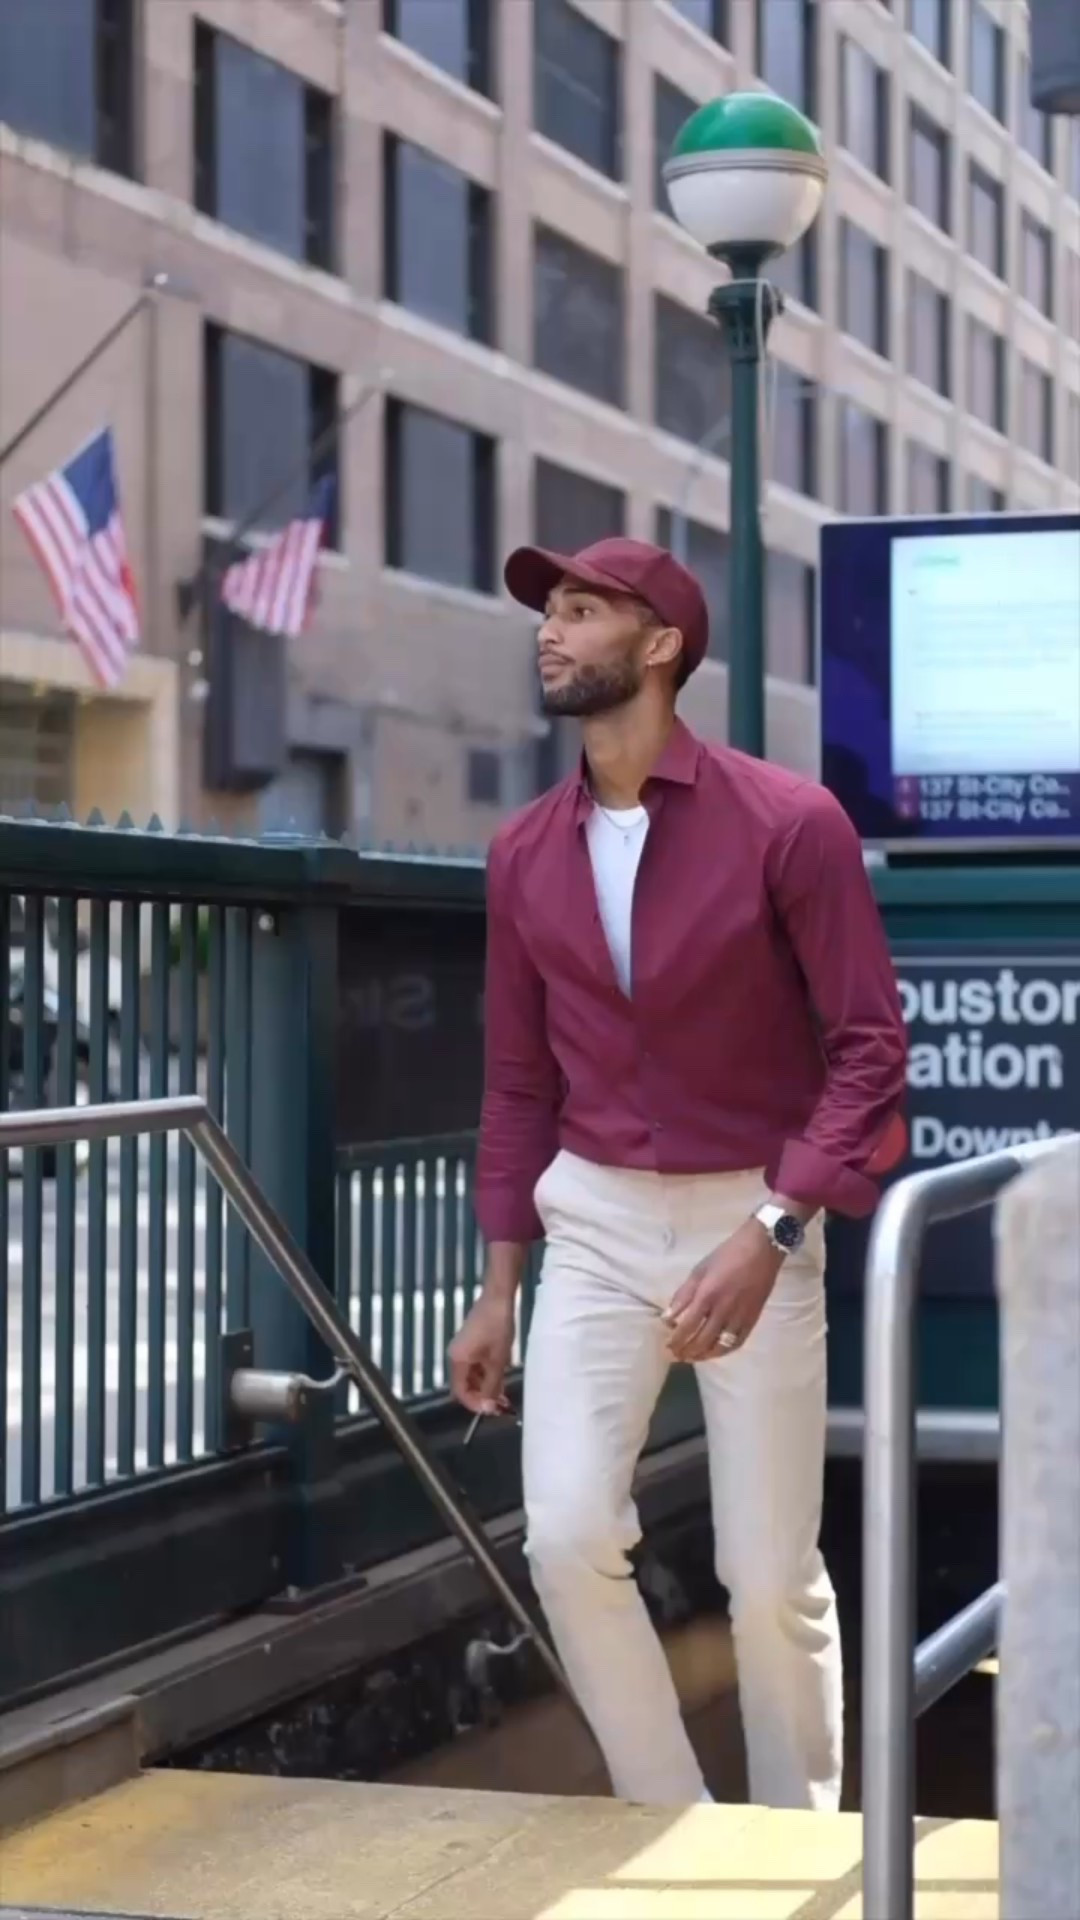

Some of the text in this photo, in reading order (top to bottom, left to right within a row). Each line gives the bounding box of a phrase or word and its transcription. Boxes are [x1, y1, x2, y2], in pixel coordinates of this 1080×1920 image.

[920, 776, 953, 797] 137
[920, 799, 953, 820] 137
[911, 1116, 1076, 1158] Downt
